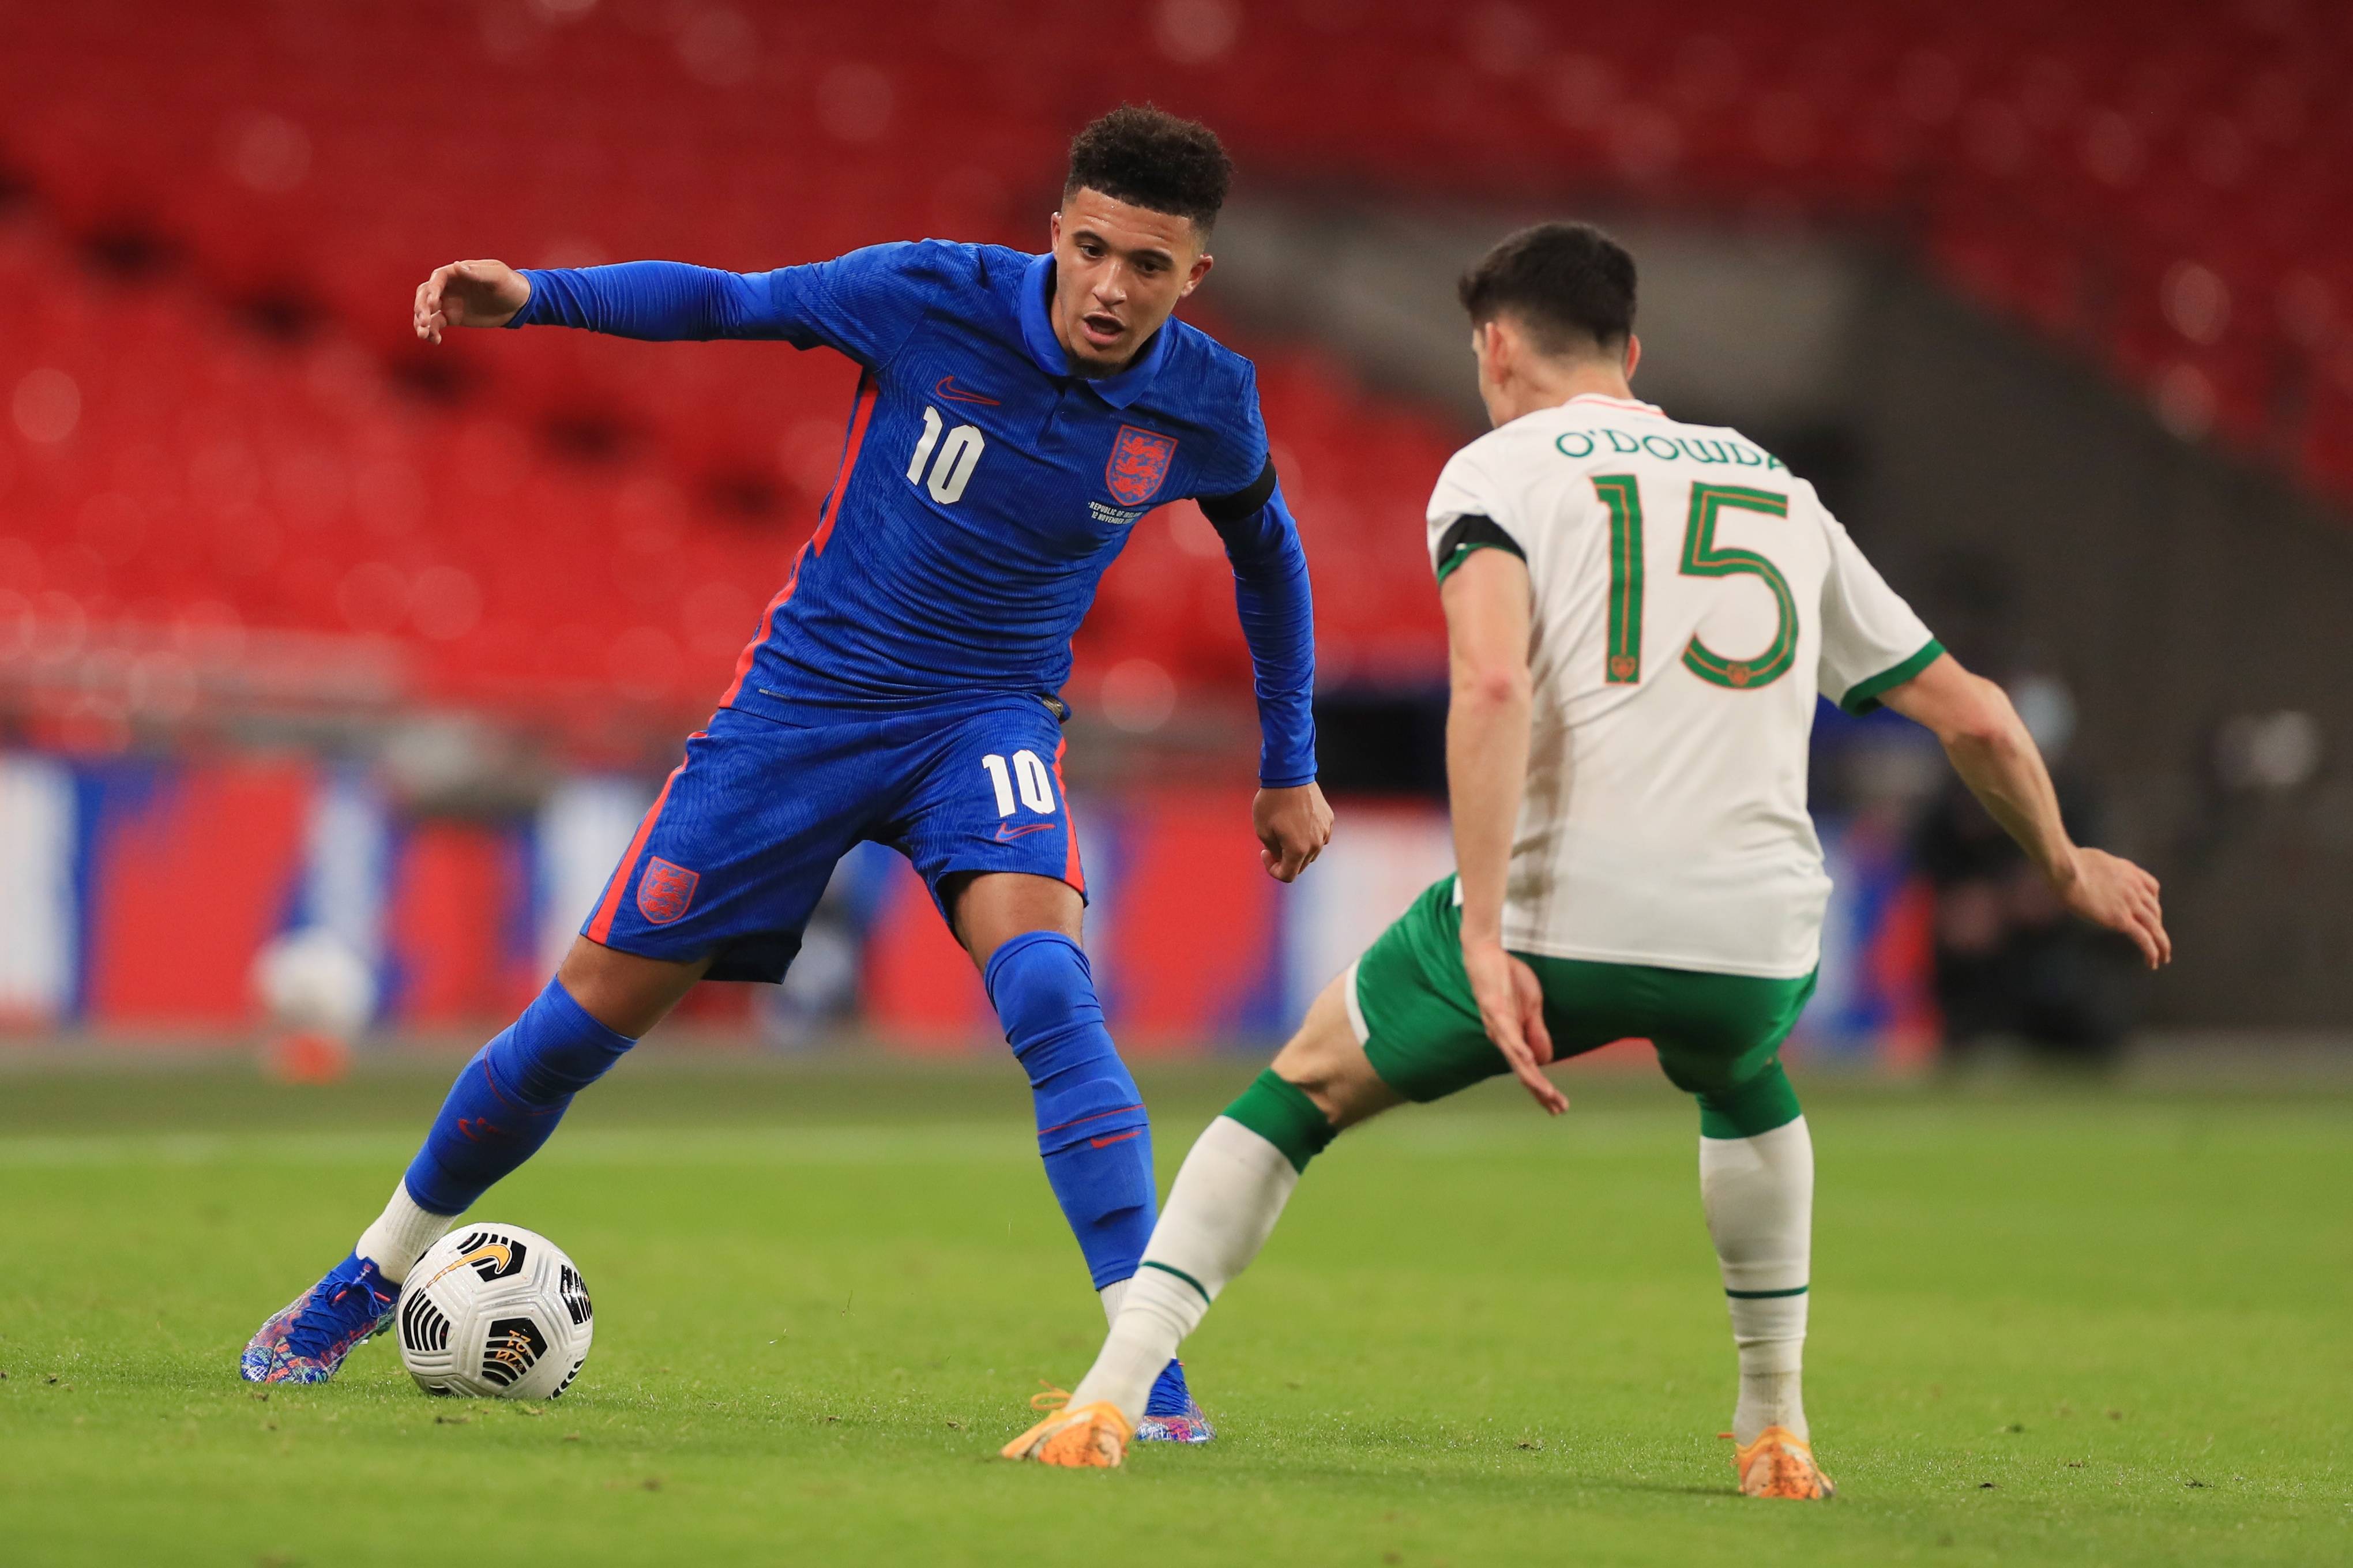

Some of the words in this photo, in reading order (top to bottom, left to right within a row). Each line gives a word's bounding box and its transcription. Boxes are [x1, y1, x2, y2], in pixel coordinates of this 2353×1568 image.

[906, 405, 986, 505] 10
[1089, 501, 1117, 515] REPUBLIC
[1098, 513, 1125, 524] NOVEMBER
[1589, 473, 1799, 691] 15
[982, 749, 1057, 818] 10
